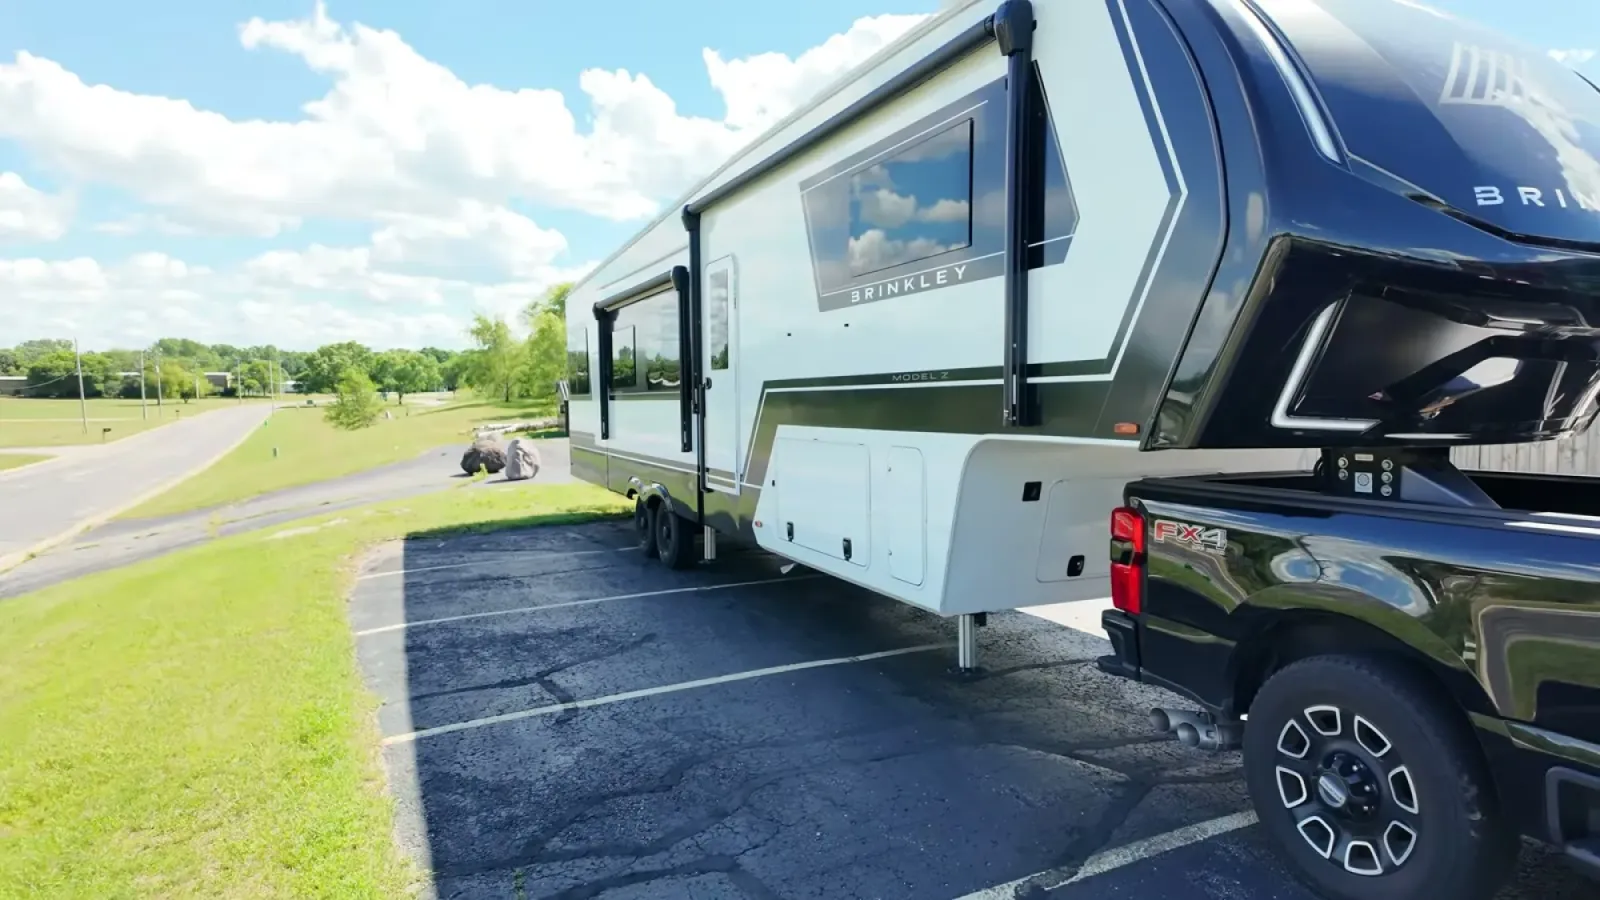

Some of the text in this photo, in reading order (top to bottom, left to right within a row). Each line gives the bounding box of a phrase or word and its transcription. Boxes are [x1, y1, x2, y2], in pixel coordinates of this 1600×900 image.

[851, 265, 967, 303] BRINKLEY
[892, 371, 949, 381] MODEL Z
[1154, 519, 1227, 550] FX4
